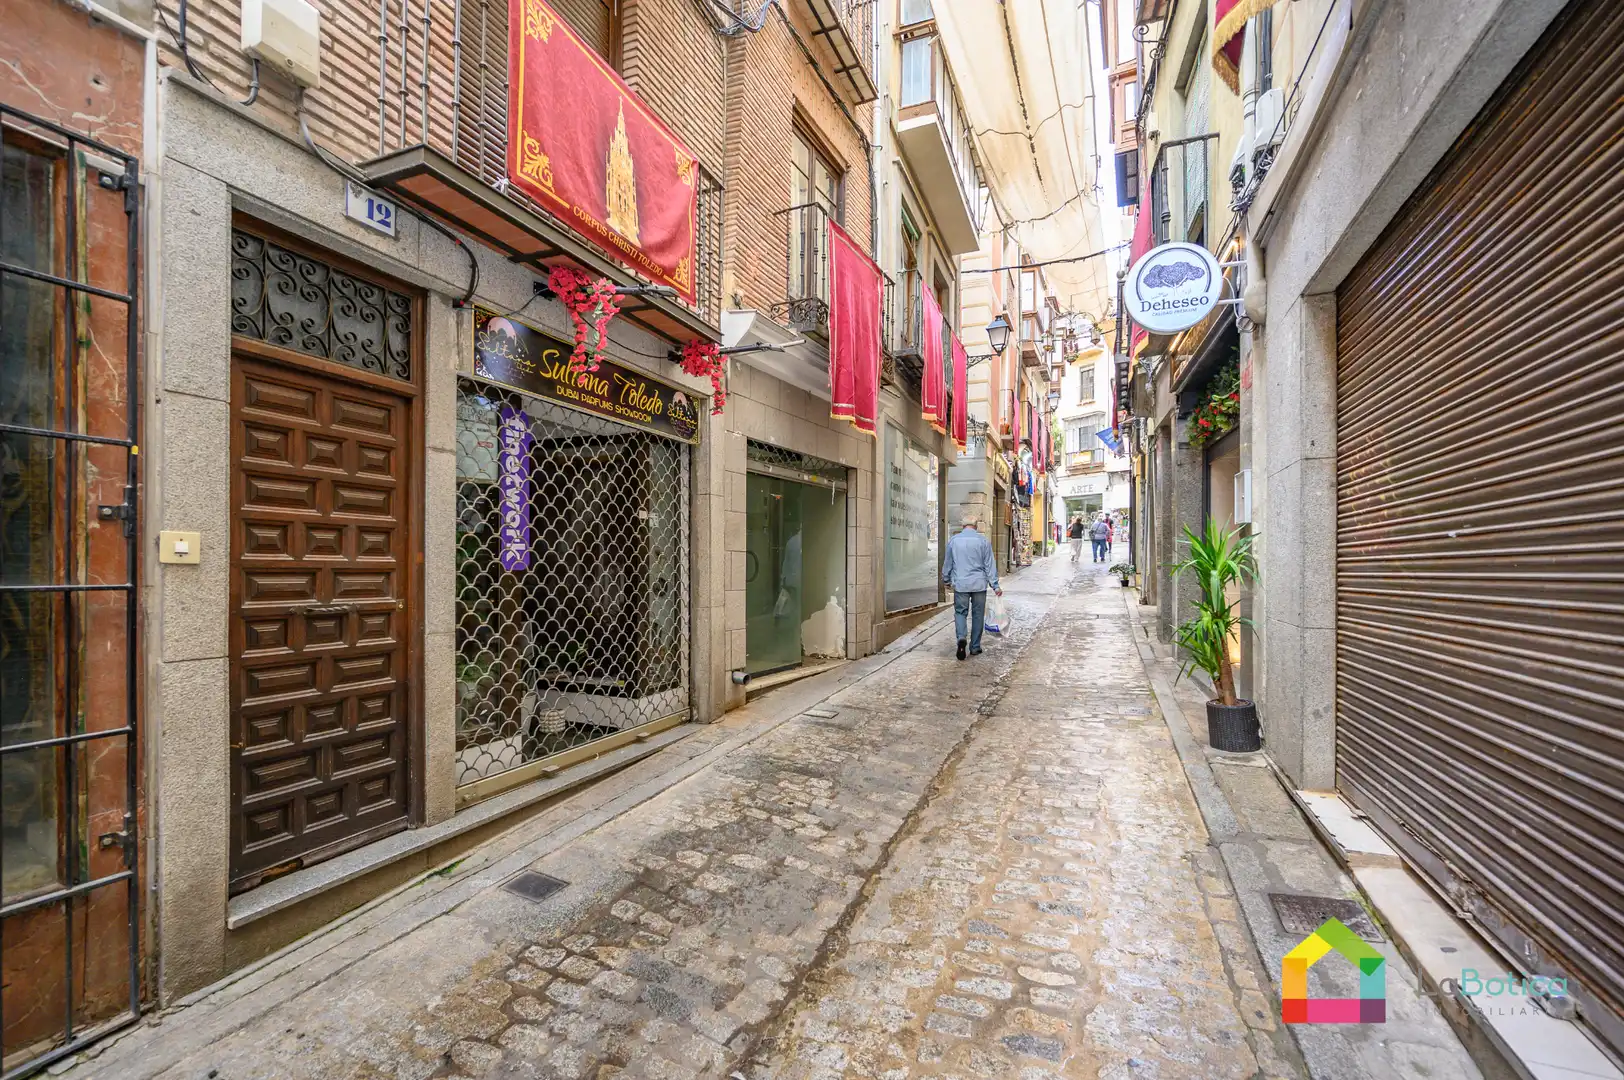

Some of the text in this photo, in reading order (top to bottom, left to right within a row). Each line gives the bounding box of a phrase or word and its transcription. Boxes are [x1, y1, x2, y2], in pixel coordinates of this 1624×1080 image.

[365, 197, 392, 228] 12
[573, 205, 664, 275] CORPUS CHRISTI TOLEDO
[1140, 295, 1210, 313] Deheseo
[540, 348, 664, 415] Sultana Toledo
[556, 385, 652, 424] DUBAI PARFUMS SHOWROOM
[505, 417, 527, 562] finetwork
[1070, 484, 1094, 495] ARTE
